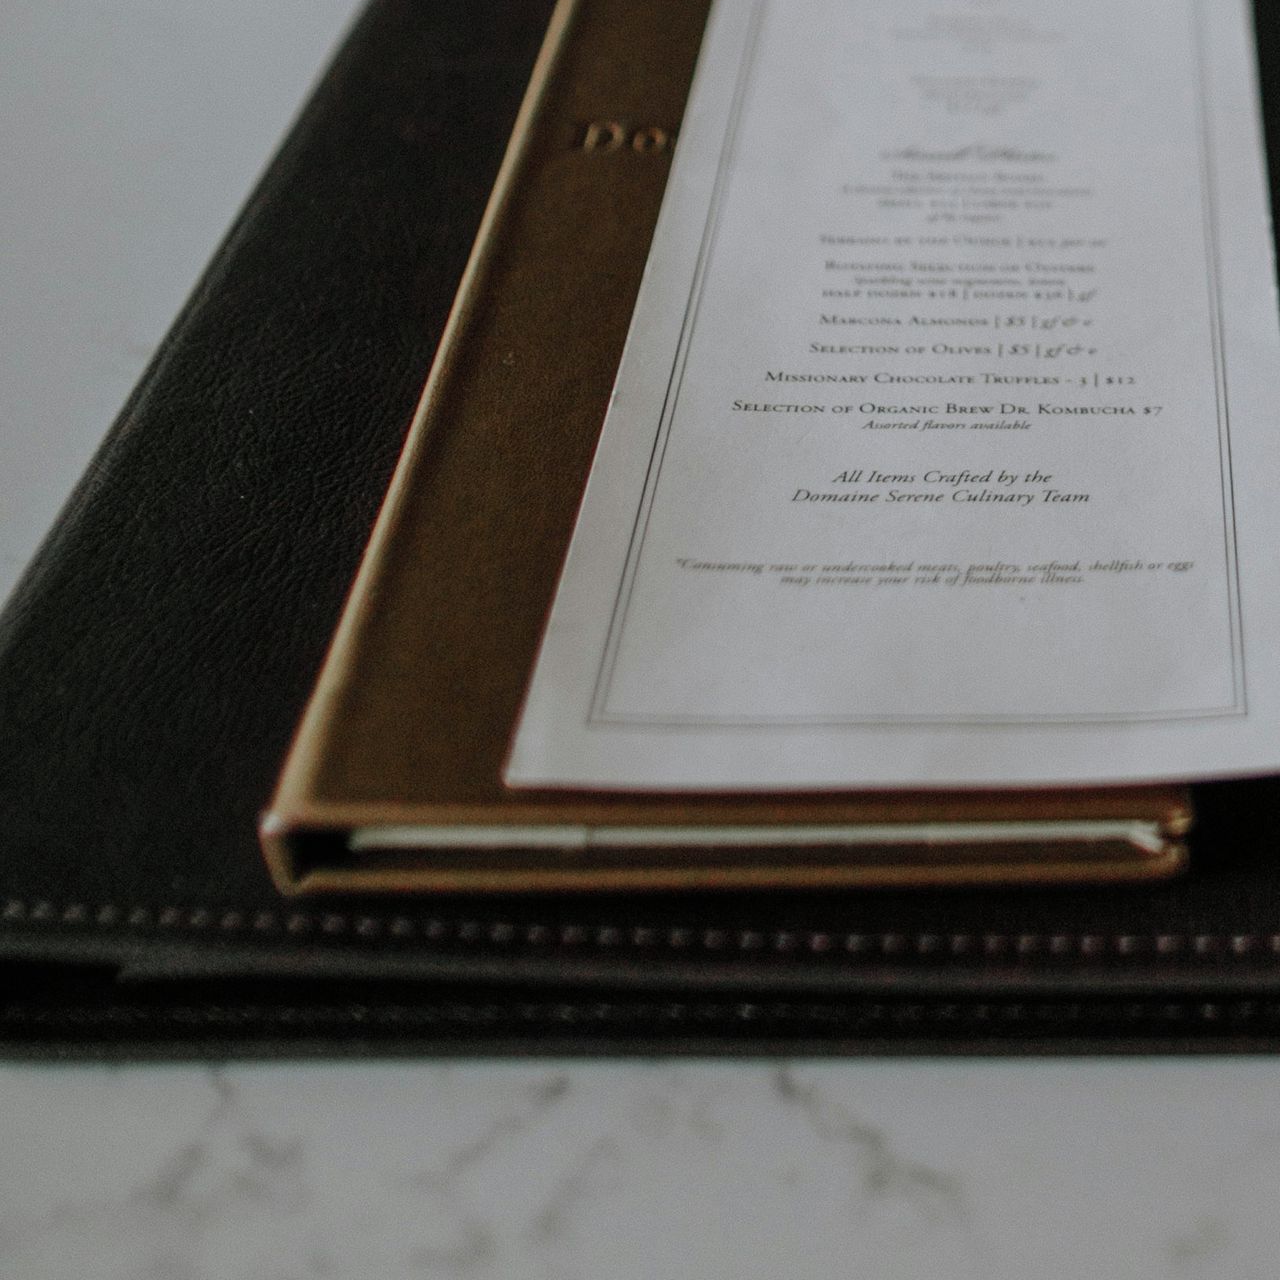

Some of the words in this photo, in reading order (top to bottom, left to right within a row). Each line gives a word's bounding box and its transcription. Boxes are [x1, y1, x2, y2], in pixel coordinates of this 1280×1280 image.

[820, 314, 902, 326] MARCONA
[909, 316, 989, 326] ALMONDS
[809, 343, 899, 354] SELECTION
[905, 345, 926, 355] OF
[932, 344, 992, 355] OLIVES
[765, 371, 867, 384] MISSIONARY
[874, 373, 974, 384] CHOCOLATE
[982, 373, 1060, 384] TRUFFLES
[1105, 376, 1136, 385] $12
[732, 400, 825, 413] SELECTION
[831, 405, 853, 414] OF
[859, 403, 939, 414] ORGANIC
[946, 403, 994, 414] BREW
[1038, 403, 1136, 415] KOMBUCHA
[1144, 405, 1163, 416] $7
[862, 420, 919, 430] Assorted
[922, 420, 967, 431] flavors
[970, 420, 1031, 431] available
[832, 470, 862, 483] All
[868, 471, 915, 483] Items
[923, 470, 993, 486] Crafted
[997, 470, 1018, 486] by
[1024, 470, 1053, 483] the
[792, 490, 879, 503] Domaine
[886, 491, 944, 503] Serene
[952, 489, 1035, 507] Culinary
[1042, 490, 1090, 503] Team
[1148, 562, 1163, 570] or
